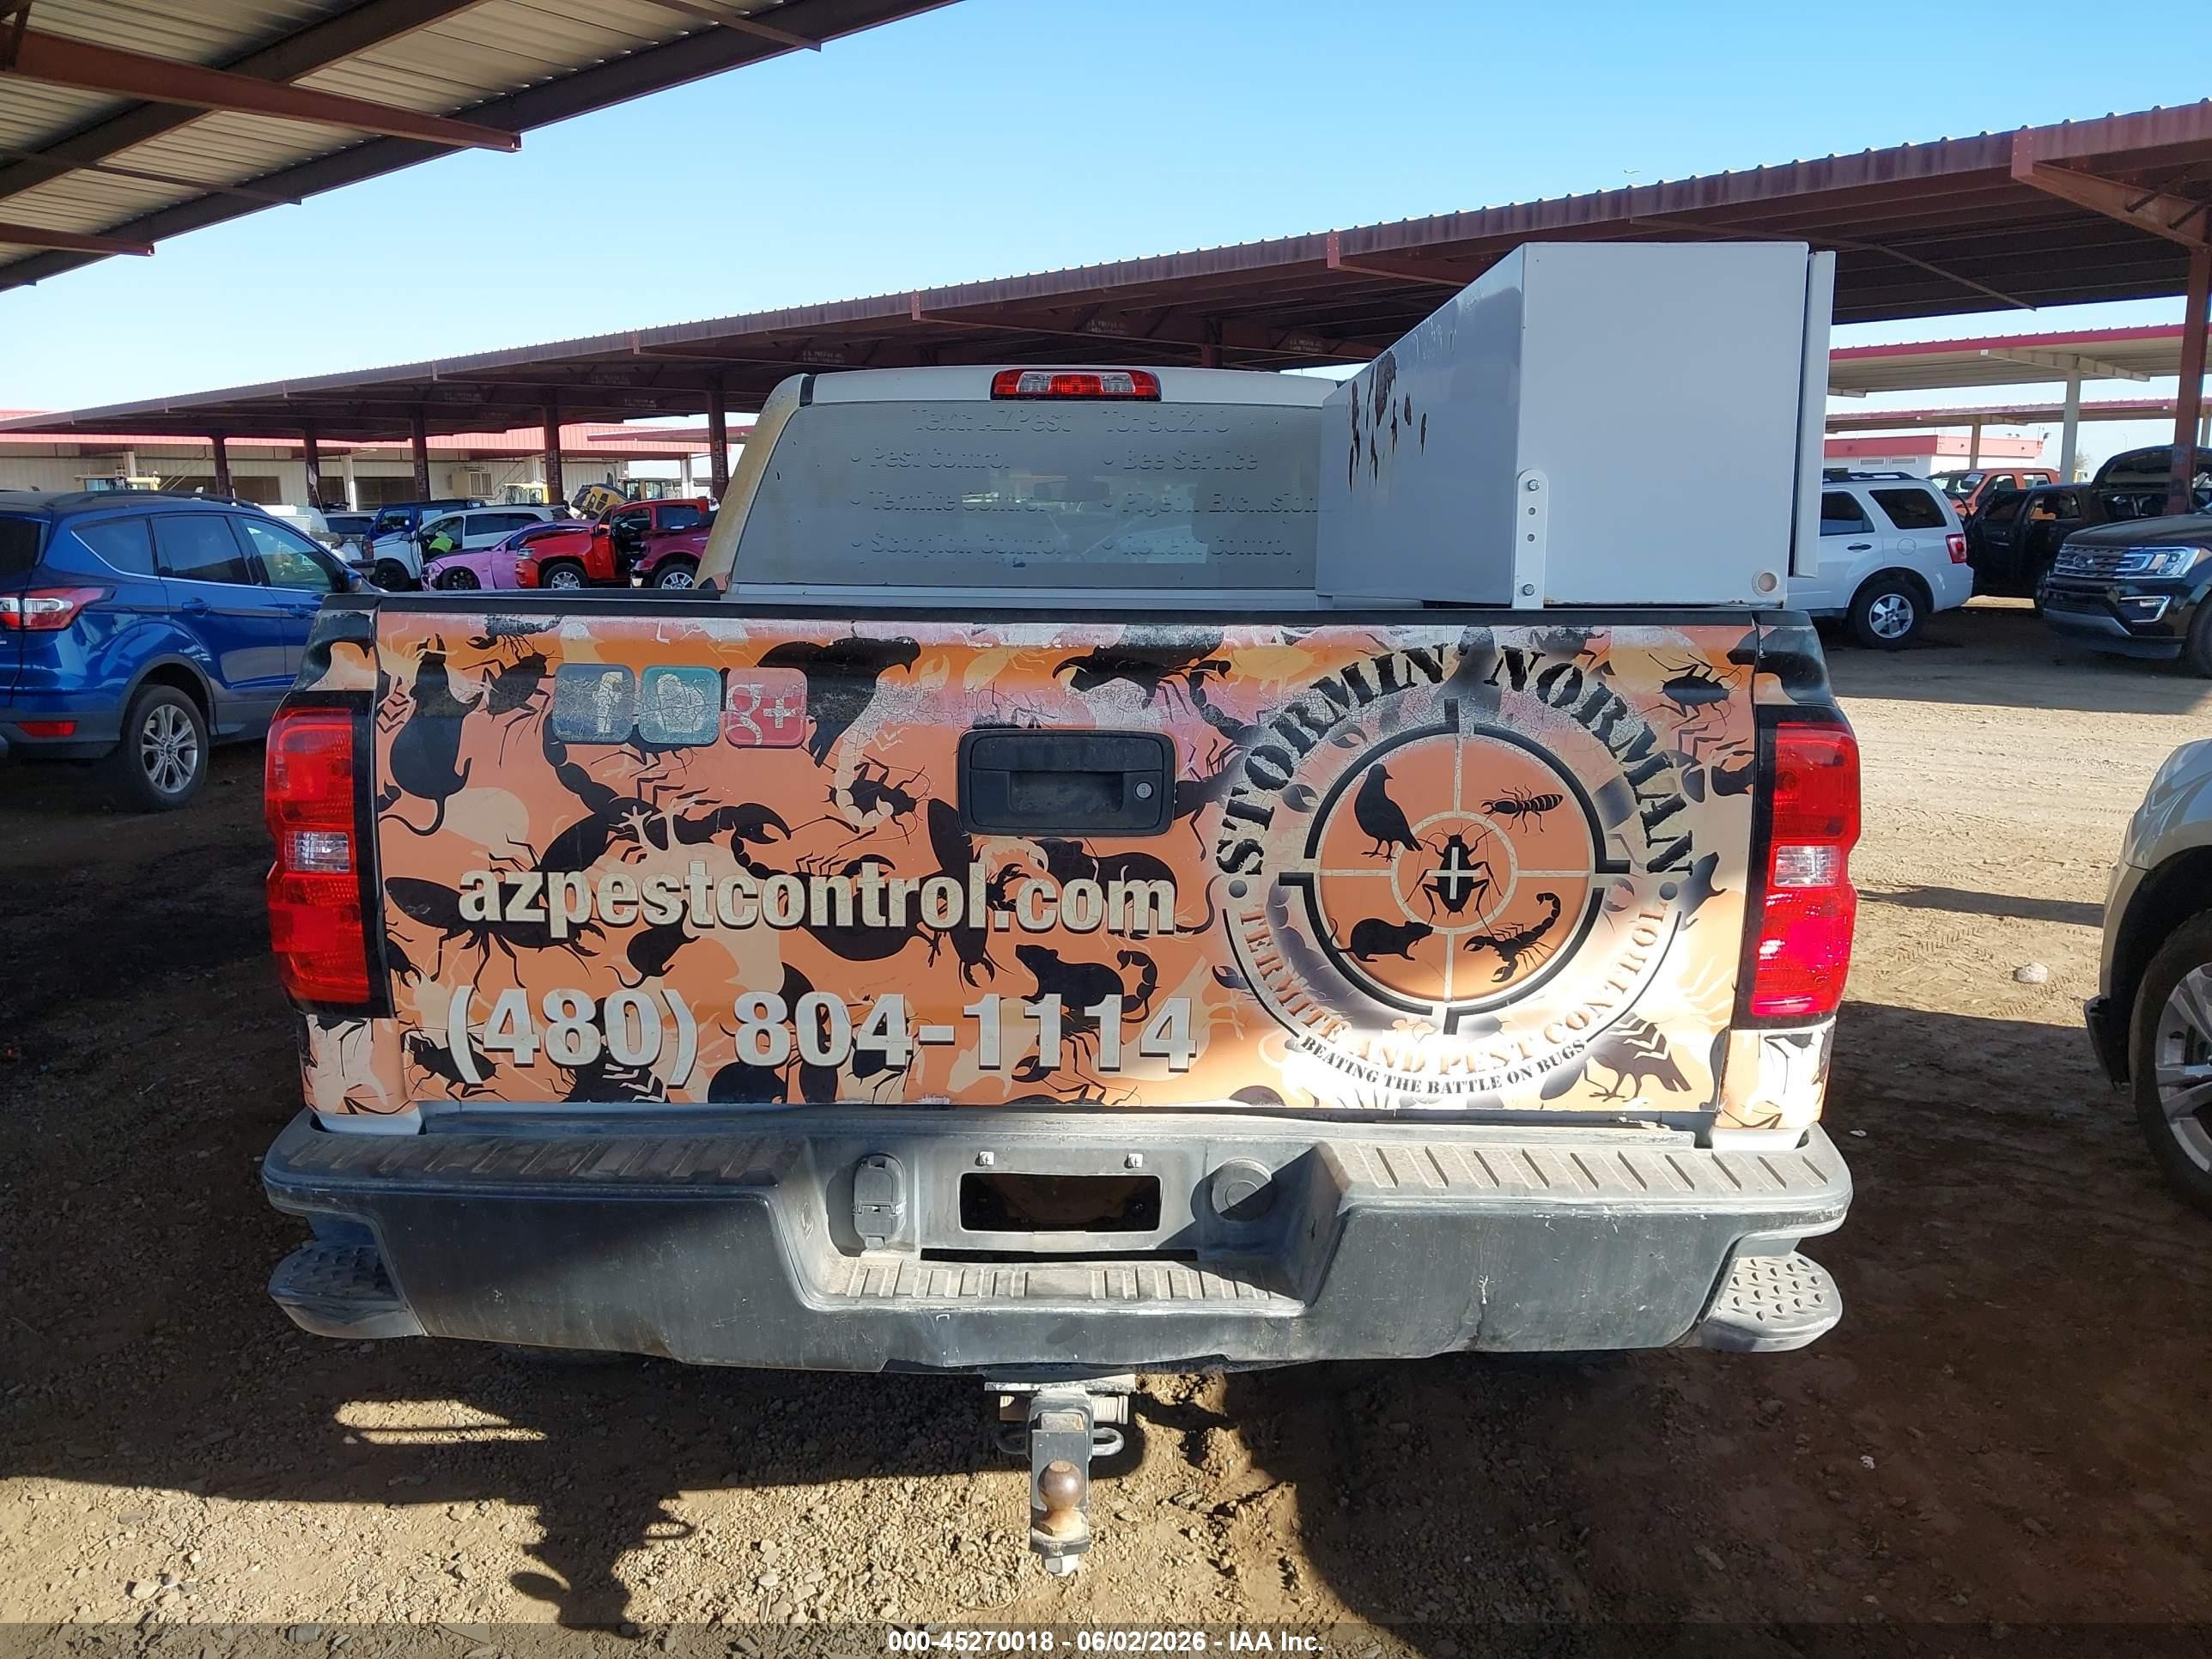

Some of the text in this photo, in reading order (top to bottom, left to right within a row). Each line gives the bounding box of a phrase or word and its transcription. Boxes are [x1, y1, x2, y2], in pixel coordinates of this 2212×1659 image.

[1483, 645, 1694, 877] NORMAN
[458, 860, 1176, 939] azpestcontrol.com
[1238, 903, 1353, 1044] TERMITE
[1544, 902, 1668, 1045] CONTROL
[446, 985, 1198, 1089] (480) 804-1114
[1300, 1035, 1586, 1094] BEATING THE BATTLE ON BUGS
